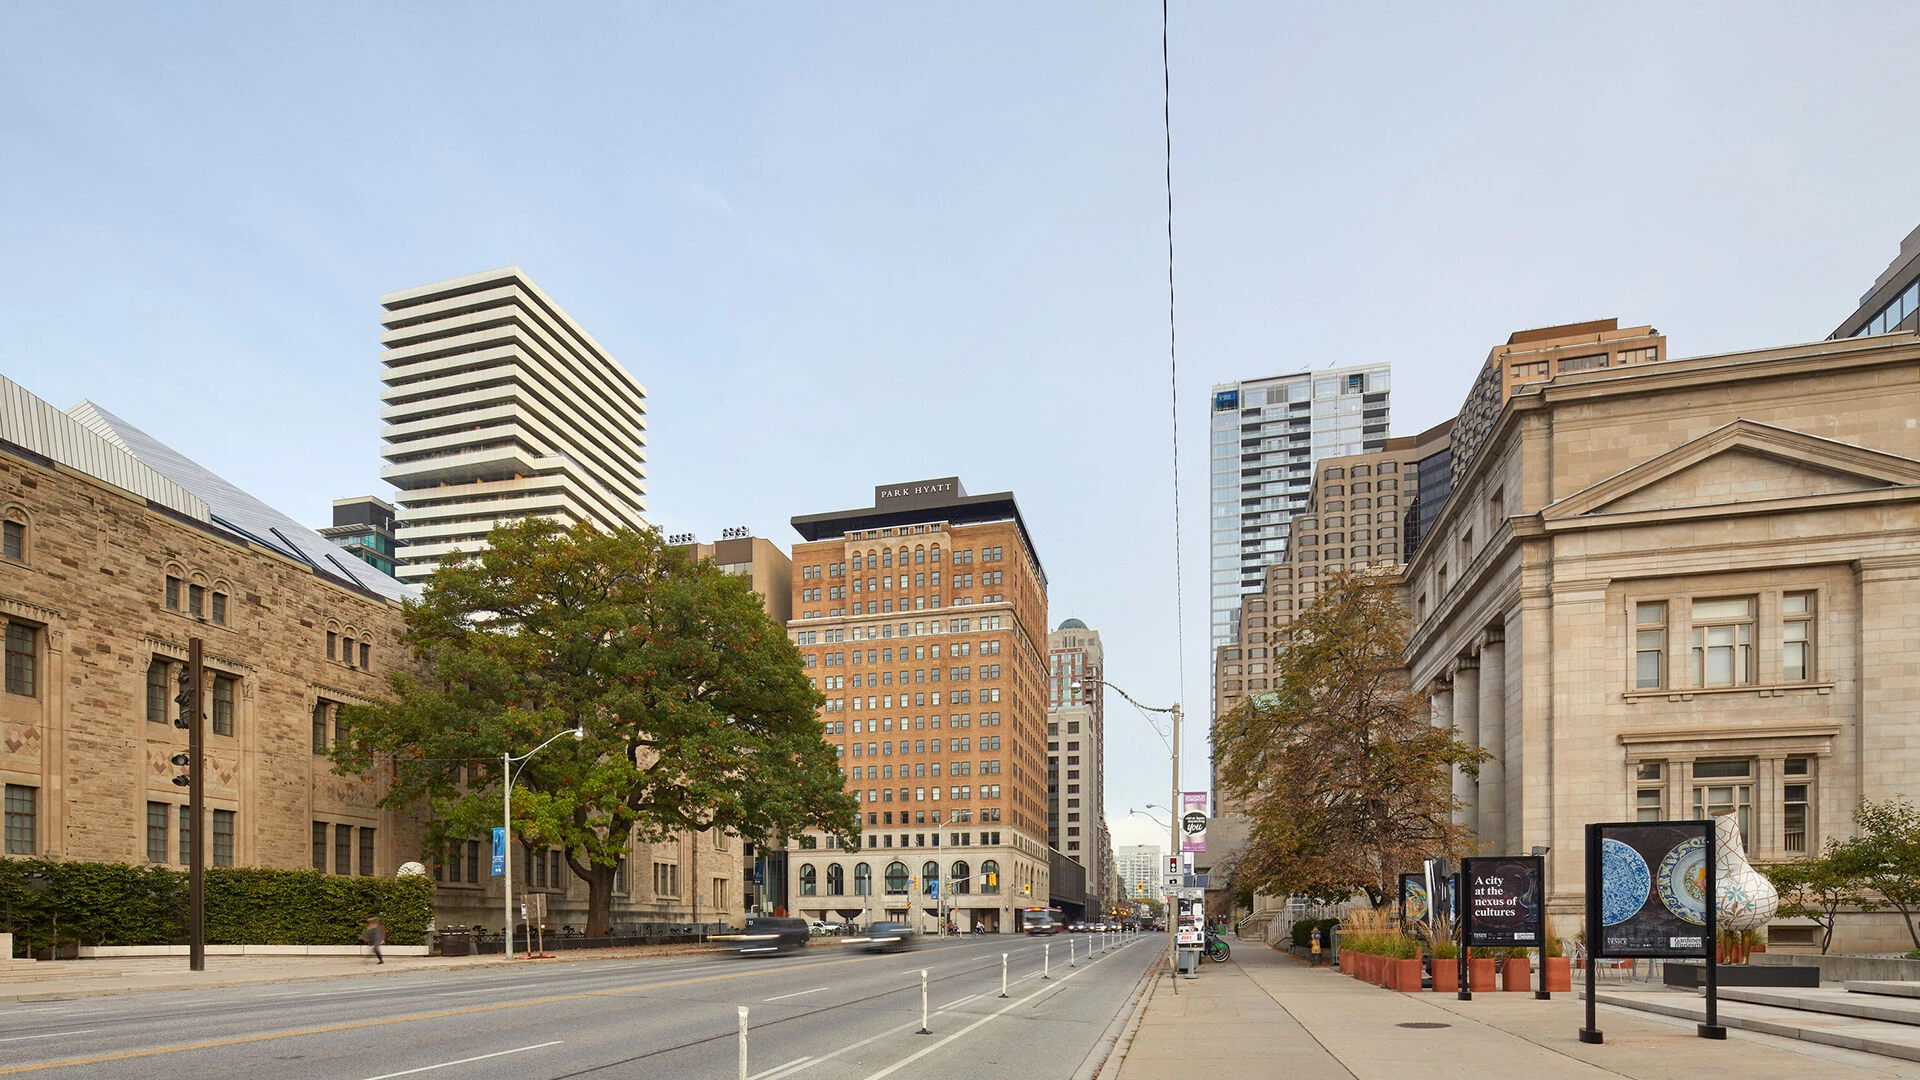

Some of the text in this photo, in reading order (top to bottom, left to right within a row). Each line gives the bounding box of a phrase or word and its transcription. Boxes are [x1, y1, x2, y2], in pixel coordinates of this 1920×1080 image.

[881, 483, 952, 498] PARK HYATT
[1187, 823, 1204, 834] you
[1474, 875, 1504, 887] A city
[1474, 886, 1504, 895] at the
[1475, 895, 1517, 906] nexus of
[1474, 907, 1516, 917] cultures
